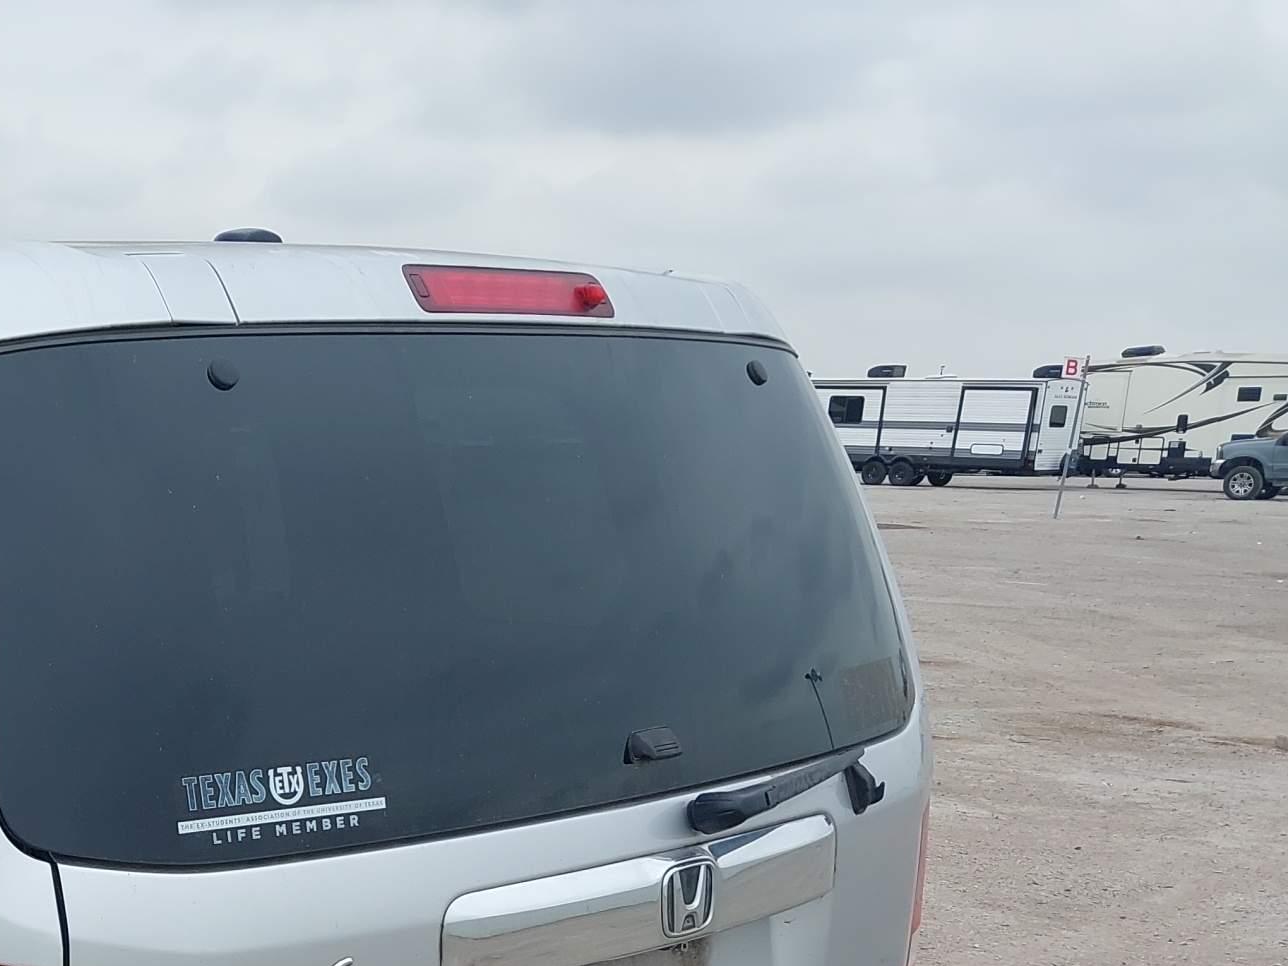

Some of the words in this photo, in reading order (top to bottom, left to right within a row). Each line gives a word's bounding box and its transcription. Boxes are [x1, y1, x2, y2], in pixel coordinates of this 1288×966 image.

[1066, 359, 1078, 376] B
[181, 769, 267, 812] TEXAS
[306, 757, 372, 798] EXES
[212, 827, 262, 845] LIFE
[275, 814, 360, 837] MEMBER
